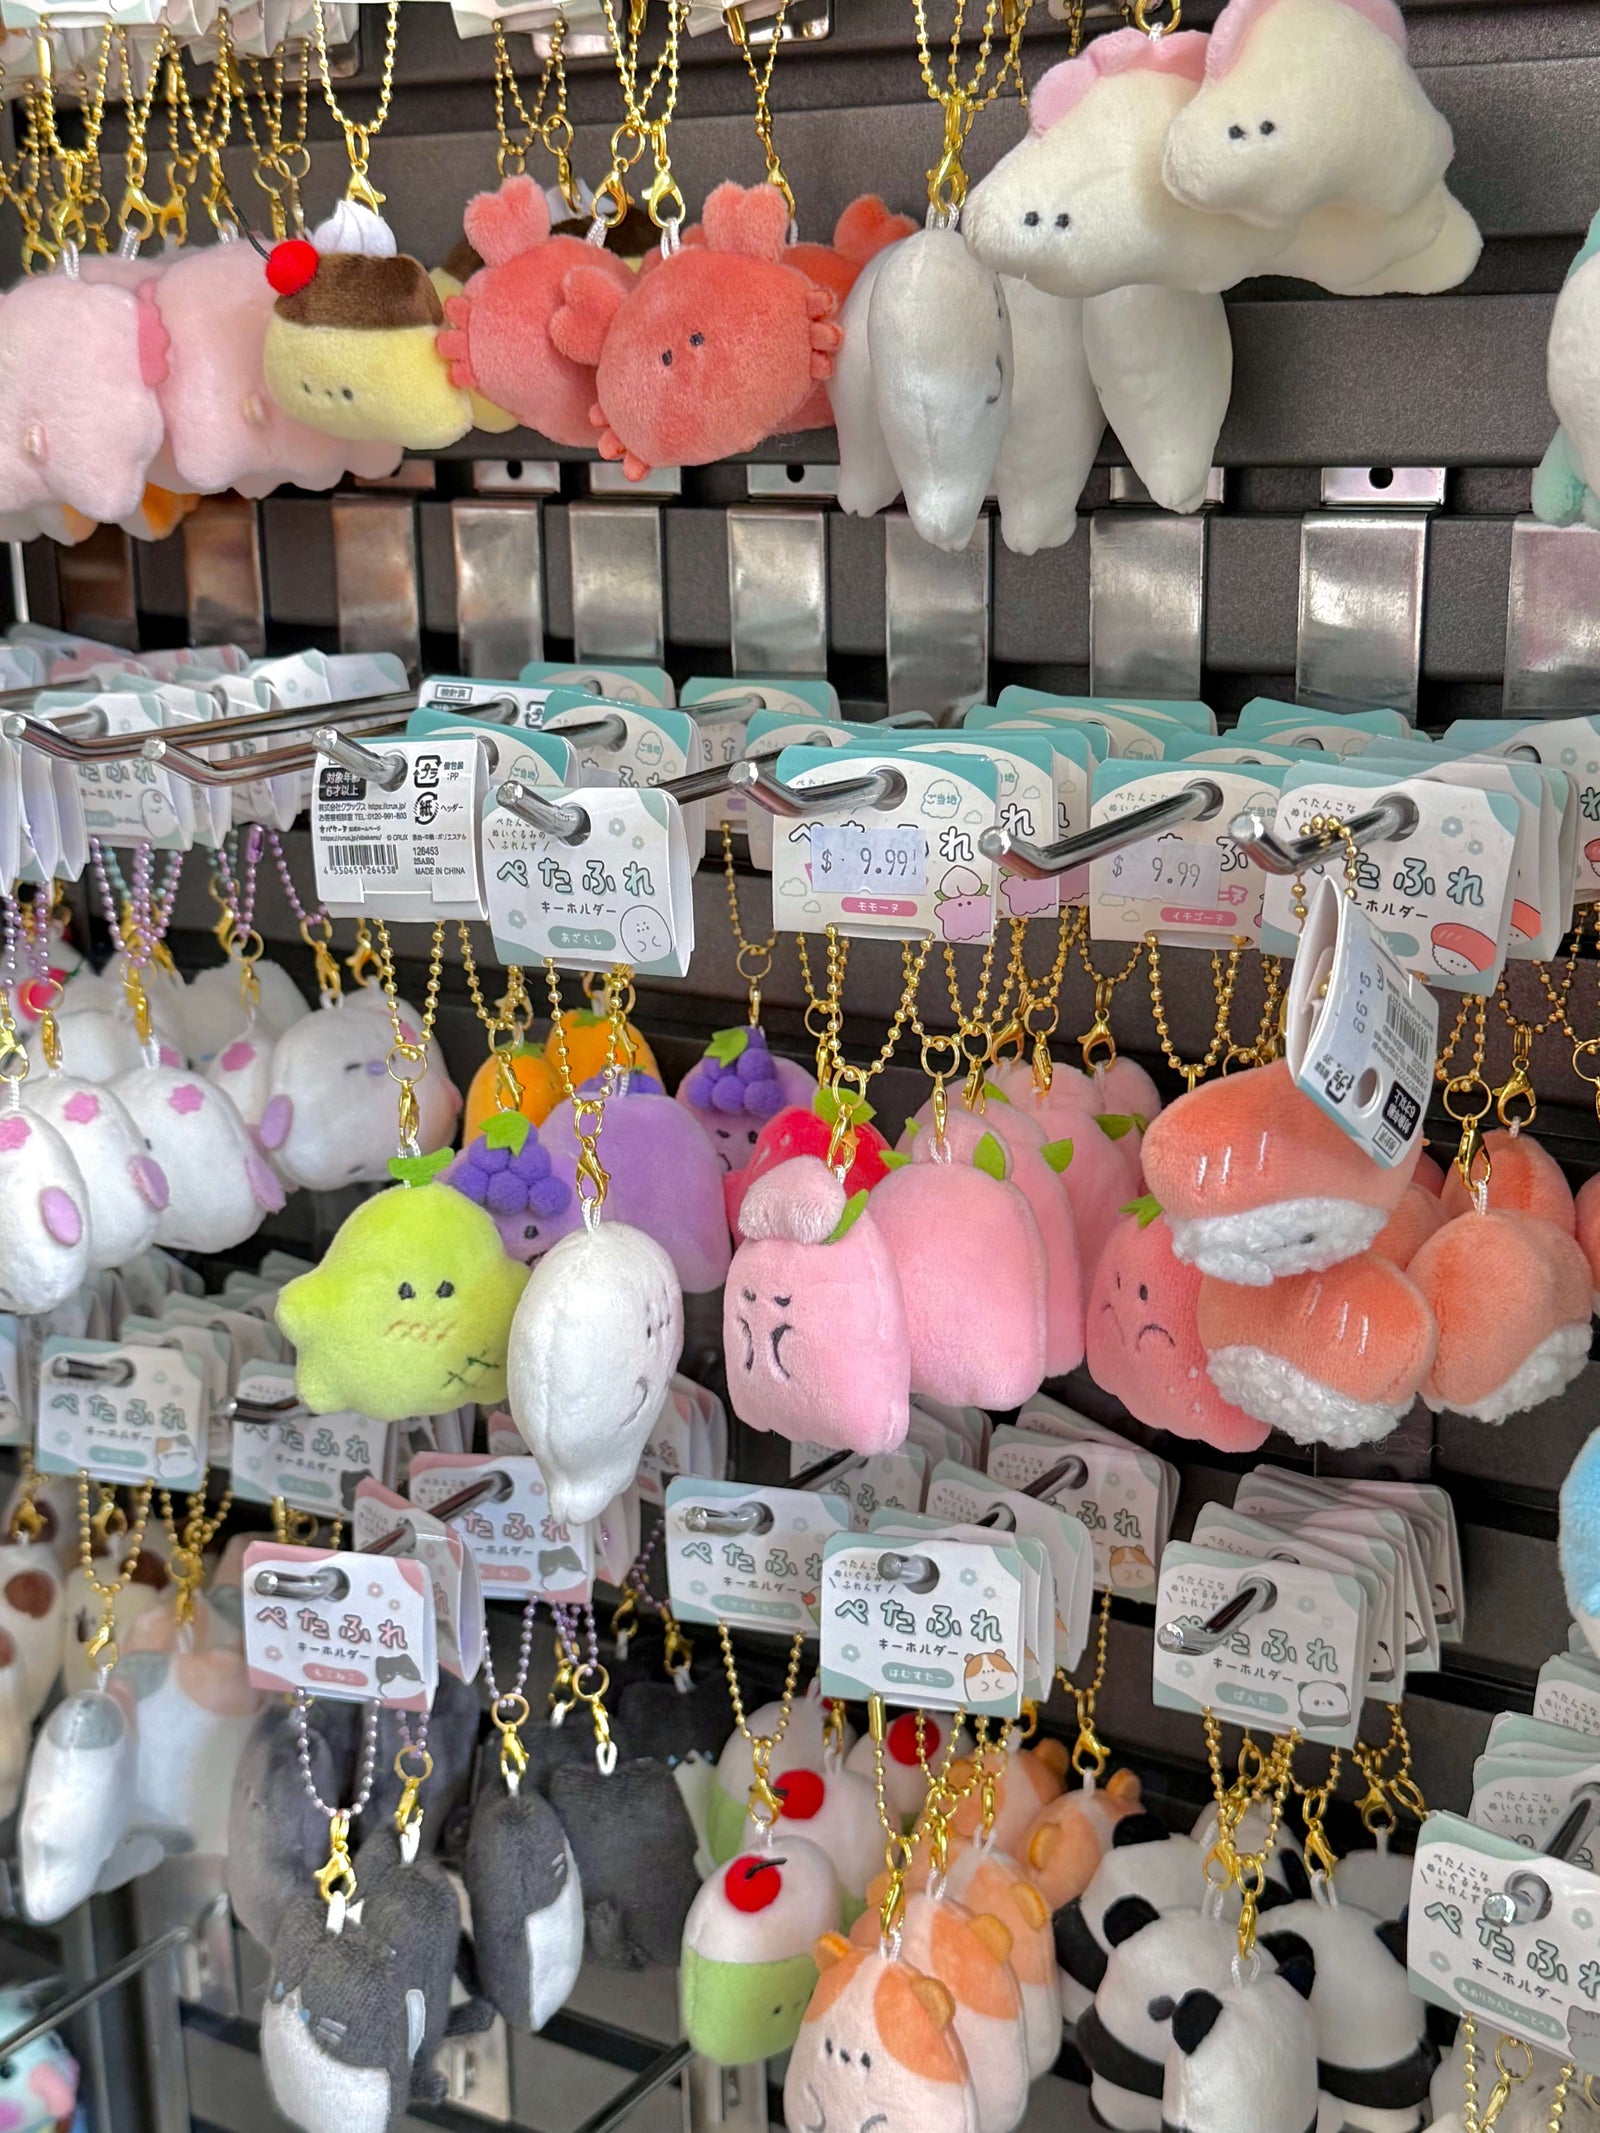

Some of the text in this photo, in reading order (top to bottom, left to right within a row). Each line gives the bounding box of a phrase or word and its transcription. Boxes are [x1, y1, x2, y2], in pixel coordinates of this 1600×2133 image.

[926, 793, 958, 806] ご当地
[440, 803, 464, 815] ヘッダー
[413, 847, 440, 856] 126453
[415, 867, 466, 875] MADE IN CHINA
[496, 857, 656, 897] ぺたふれ
[1112, 854, 1201, 888] $ 9.99
[1338, 852, 1485, 906] たふれ
[541, 901, 617, 916] キーホルダー
[858, 901, 900, 913] モモーヌ
[1353, 900, 1429, 919] ーホルダー
[561, 932, 603, 945] あざらし
[462, 1510, 570, 1542] たふれ
[474, 1545, 535, 1556] ーホルダー
[839, 1559, 878, 1571] ぺたんこ
[723, 1576, 797, 1593] キーホルダー
[833, 1570, 894, 1583] ぬいぐるみ
[256, 1605, 409, 1650] ぺたふれ
[835, 1598, 1003, 1643] ぺたふれ
[297, 1641, 371, 1660] キーホルダー
[878, 1638, 959, 1657] キーホルダー
[889, 1668, 947, 1683] はむすたー
[1212, 1657, 1294, 1683] キーホルダー
[1472, 1957, 1564, 2004] キーホルダー
